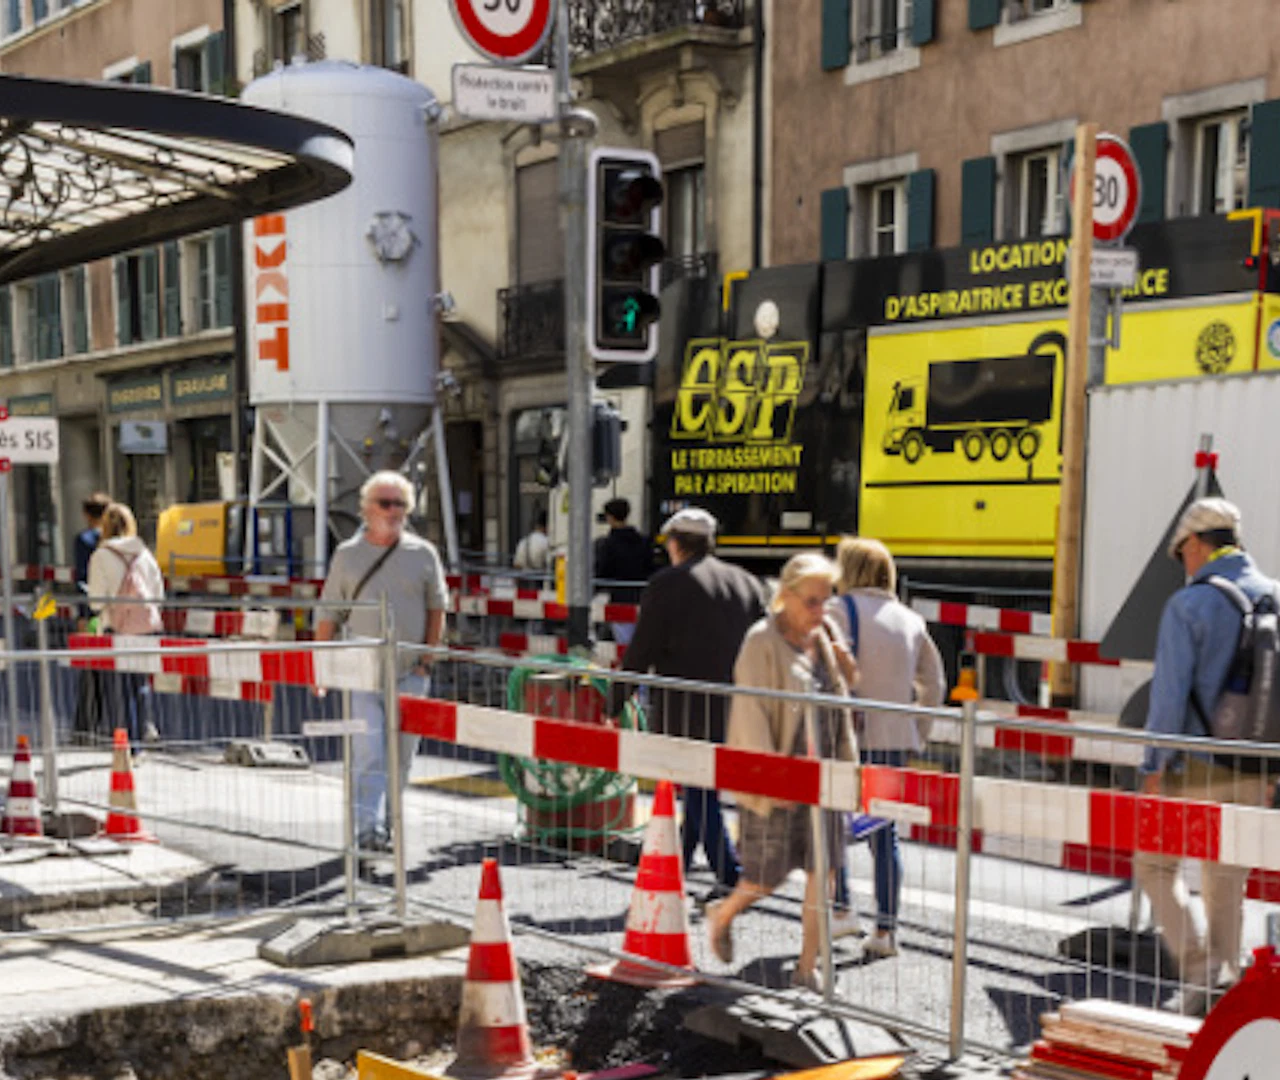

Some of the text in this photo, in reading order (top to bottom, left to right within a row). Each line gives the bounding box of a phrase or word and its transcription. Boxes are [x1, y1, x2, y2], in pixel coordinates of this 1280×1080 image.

[1093, 174, 1119, 208] 30
[972, 240, 1072, 274] LOCATION
[254, 212, 289, 372] IXIT
[885, 283, 1023, 320] D'ASPIRATRICE
[24, 429, 54, 450] SIS
[671, 446, 803, 470] LE TERRASSEMENT
[674, 471, 798, 495] PAR ASPIRATION
